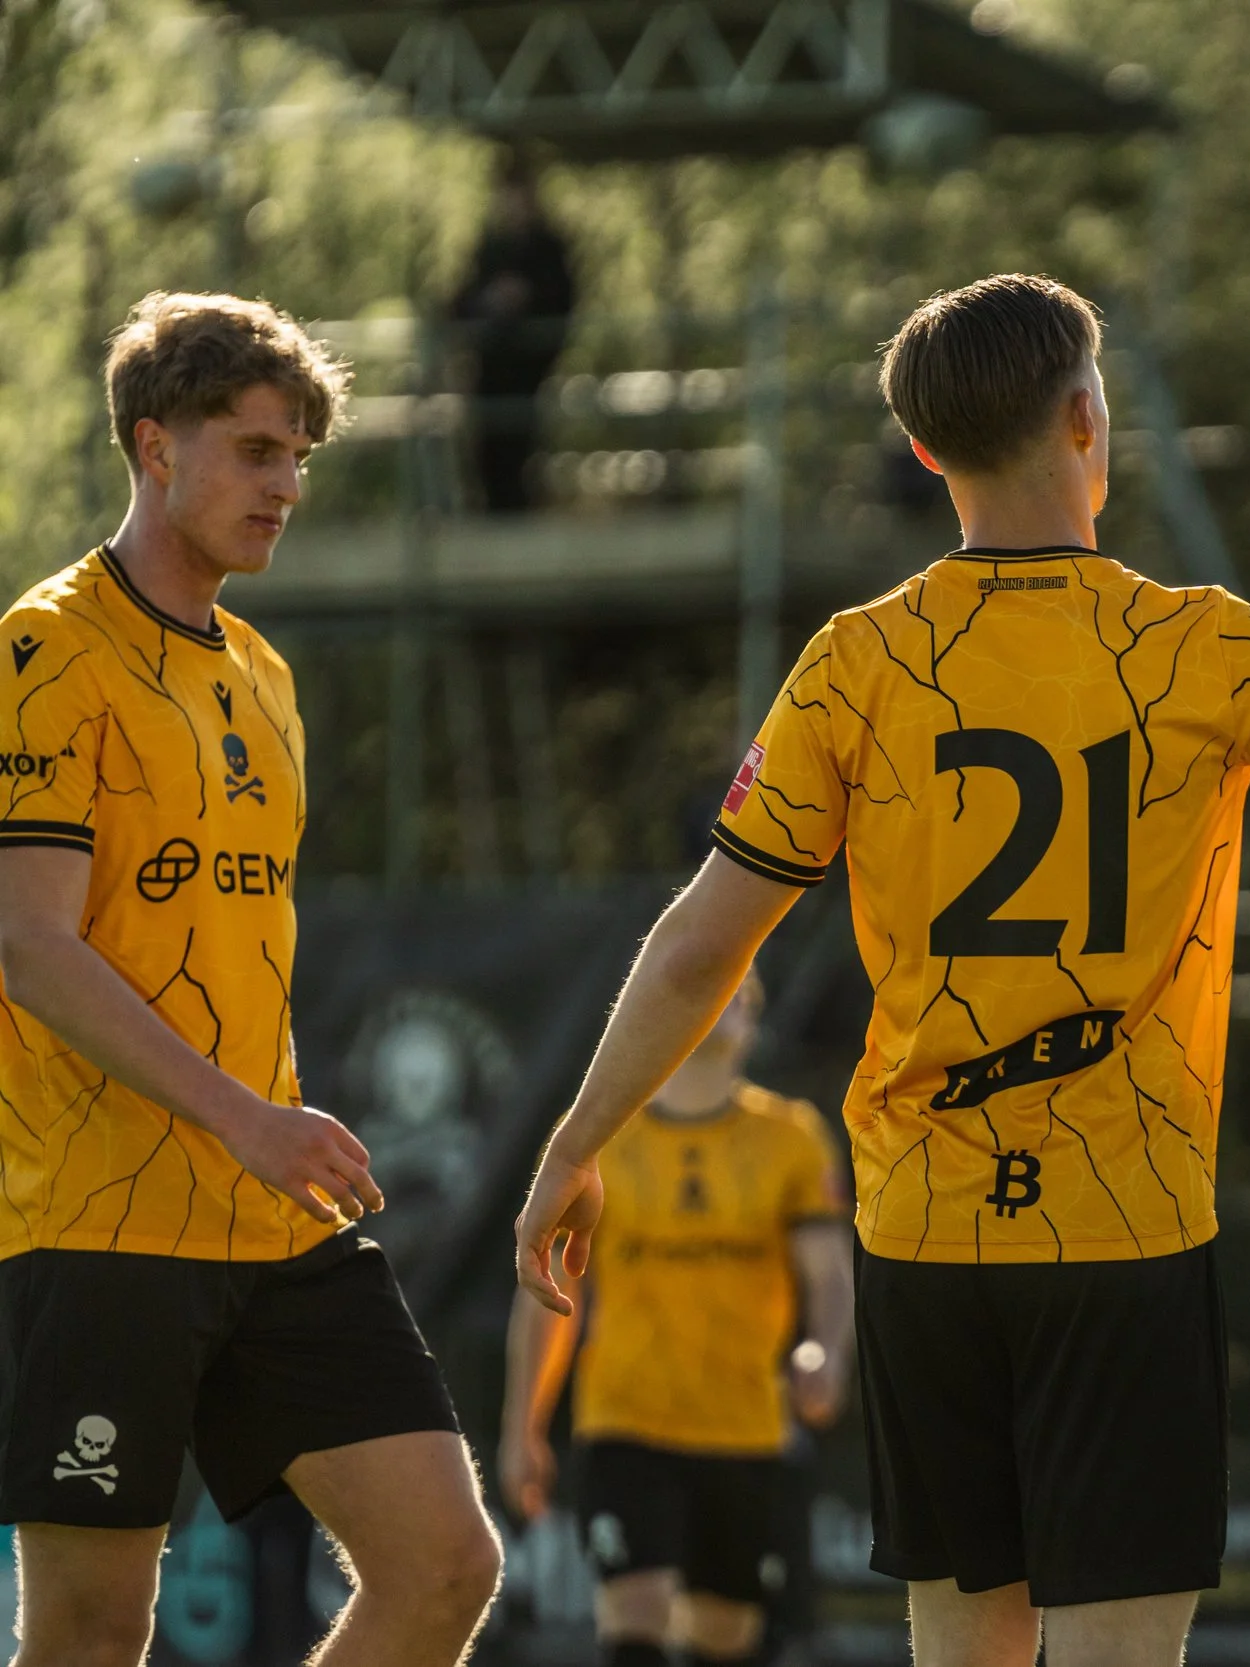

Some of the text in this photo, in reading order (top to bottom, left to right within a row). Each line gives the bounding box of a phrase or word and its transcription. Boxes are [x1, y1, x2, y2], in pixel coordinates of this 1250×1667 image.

[978, 576, 1067, 590] RUNNING BITCOIN
[929, 728, 1130, 957] 21
[214, 851, 293, 898] GEM
